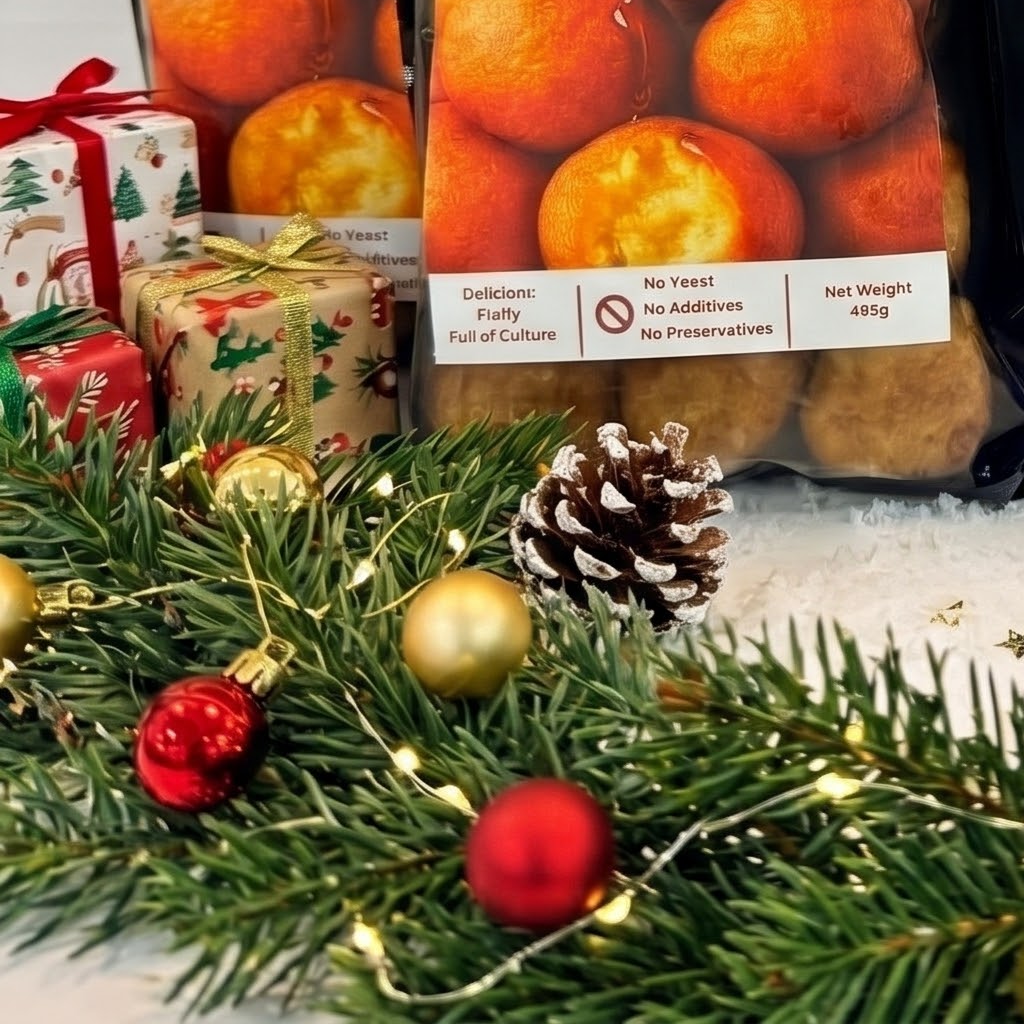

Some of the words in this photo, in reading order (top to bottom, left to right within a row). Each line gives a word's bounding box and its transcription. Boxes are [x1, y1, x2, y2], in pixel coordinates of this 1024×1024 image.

[644, 277, 665, 290] No
[825, 285, 852, 298] Net
[856, 281, 912, 298] Weight
[644, 303, 665, 315] No
[670, 299, 744, 314] Additives
[449, 330, 476, 344] Full
[480, 329, 497, 343] of
[500, 328, 557, 342] Culture
[641, 328, 662, 340] No
[667, 322, 774, 339] Preservatives
